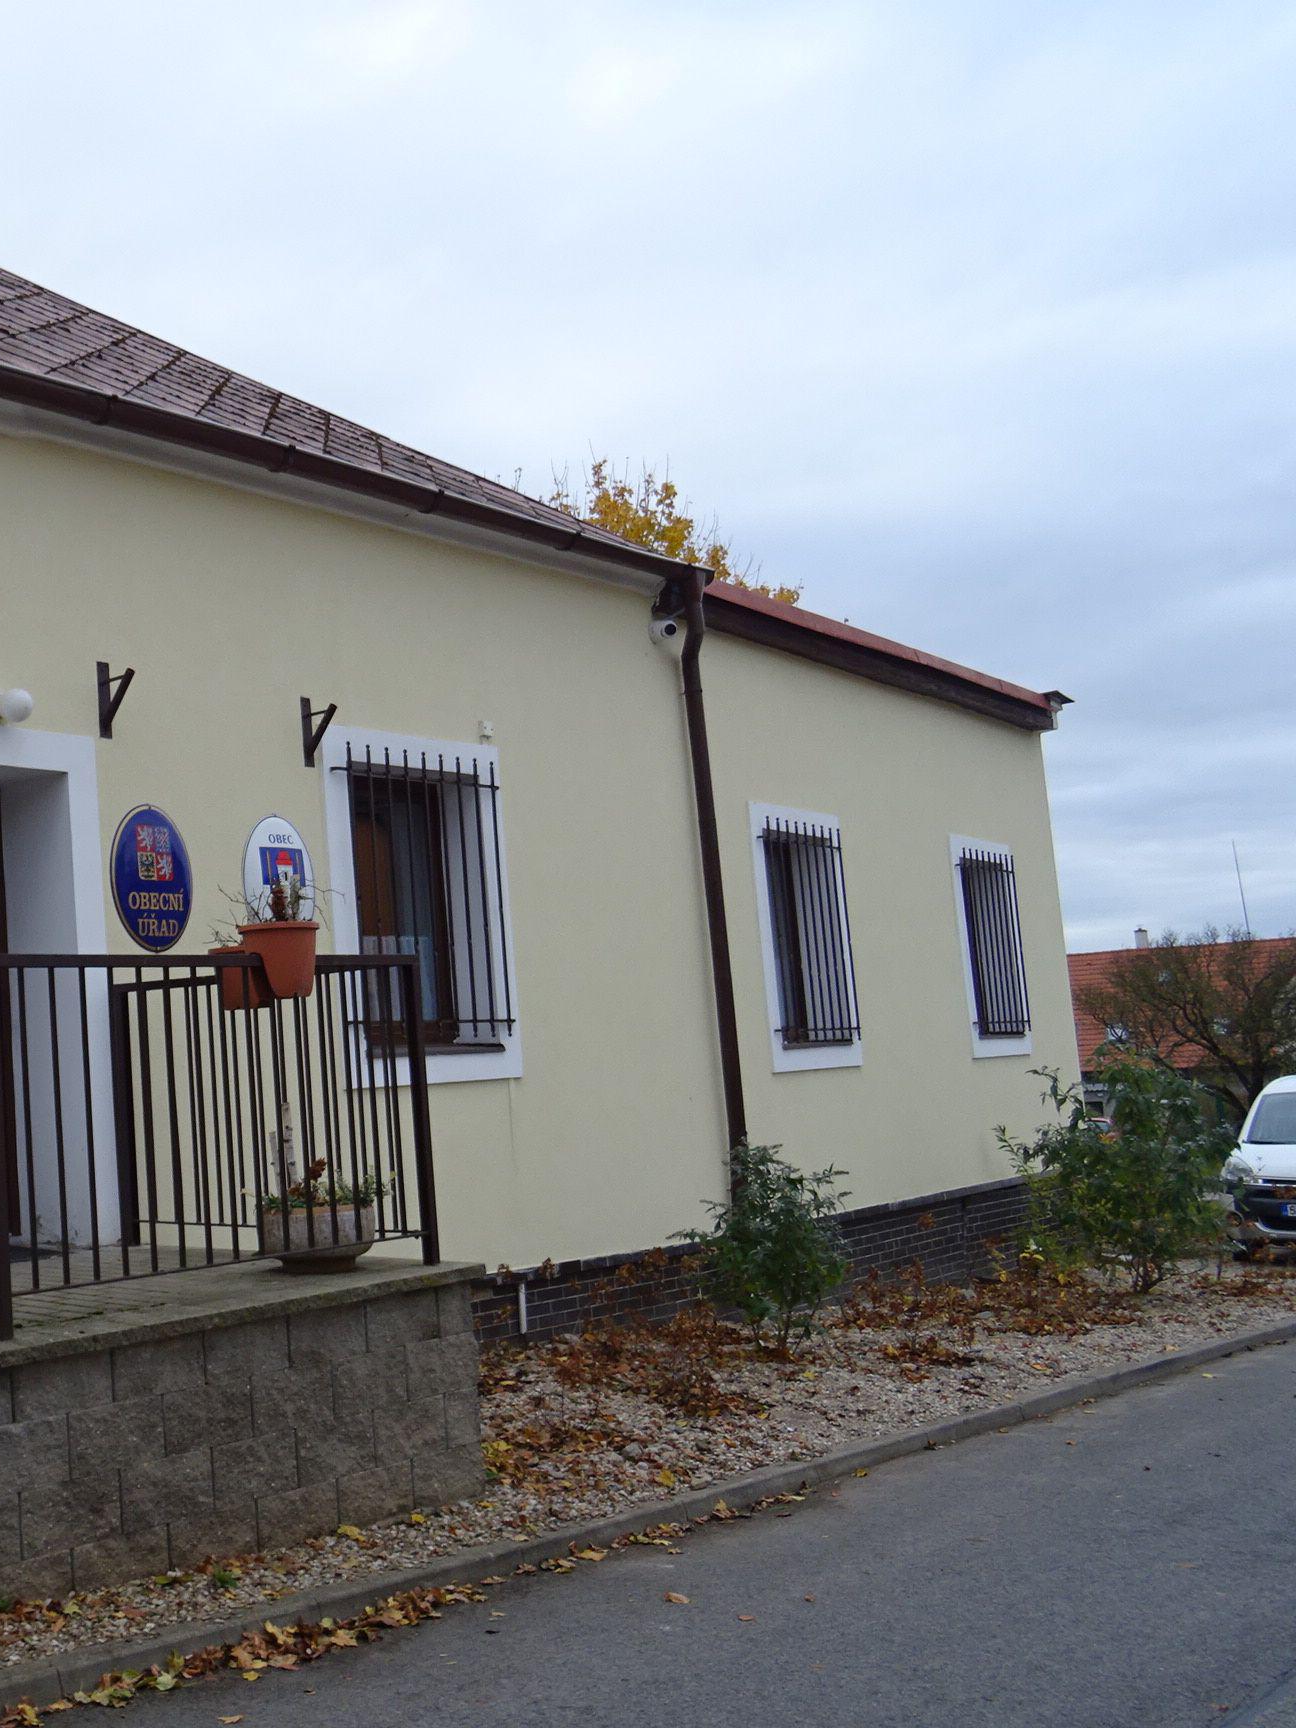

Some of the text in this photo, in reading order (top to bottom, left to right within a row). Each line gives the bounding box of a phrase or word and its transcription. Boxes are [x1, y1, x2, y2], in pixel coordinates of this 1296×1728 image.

[268, 833, 294, 845] OBEC
[128, 888, 185, 911] OBECNÍ
[137, 912, 179, 937] ÚŘAD
